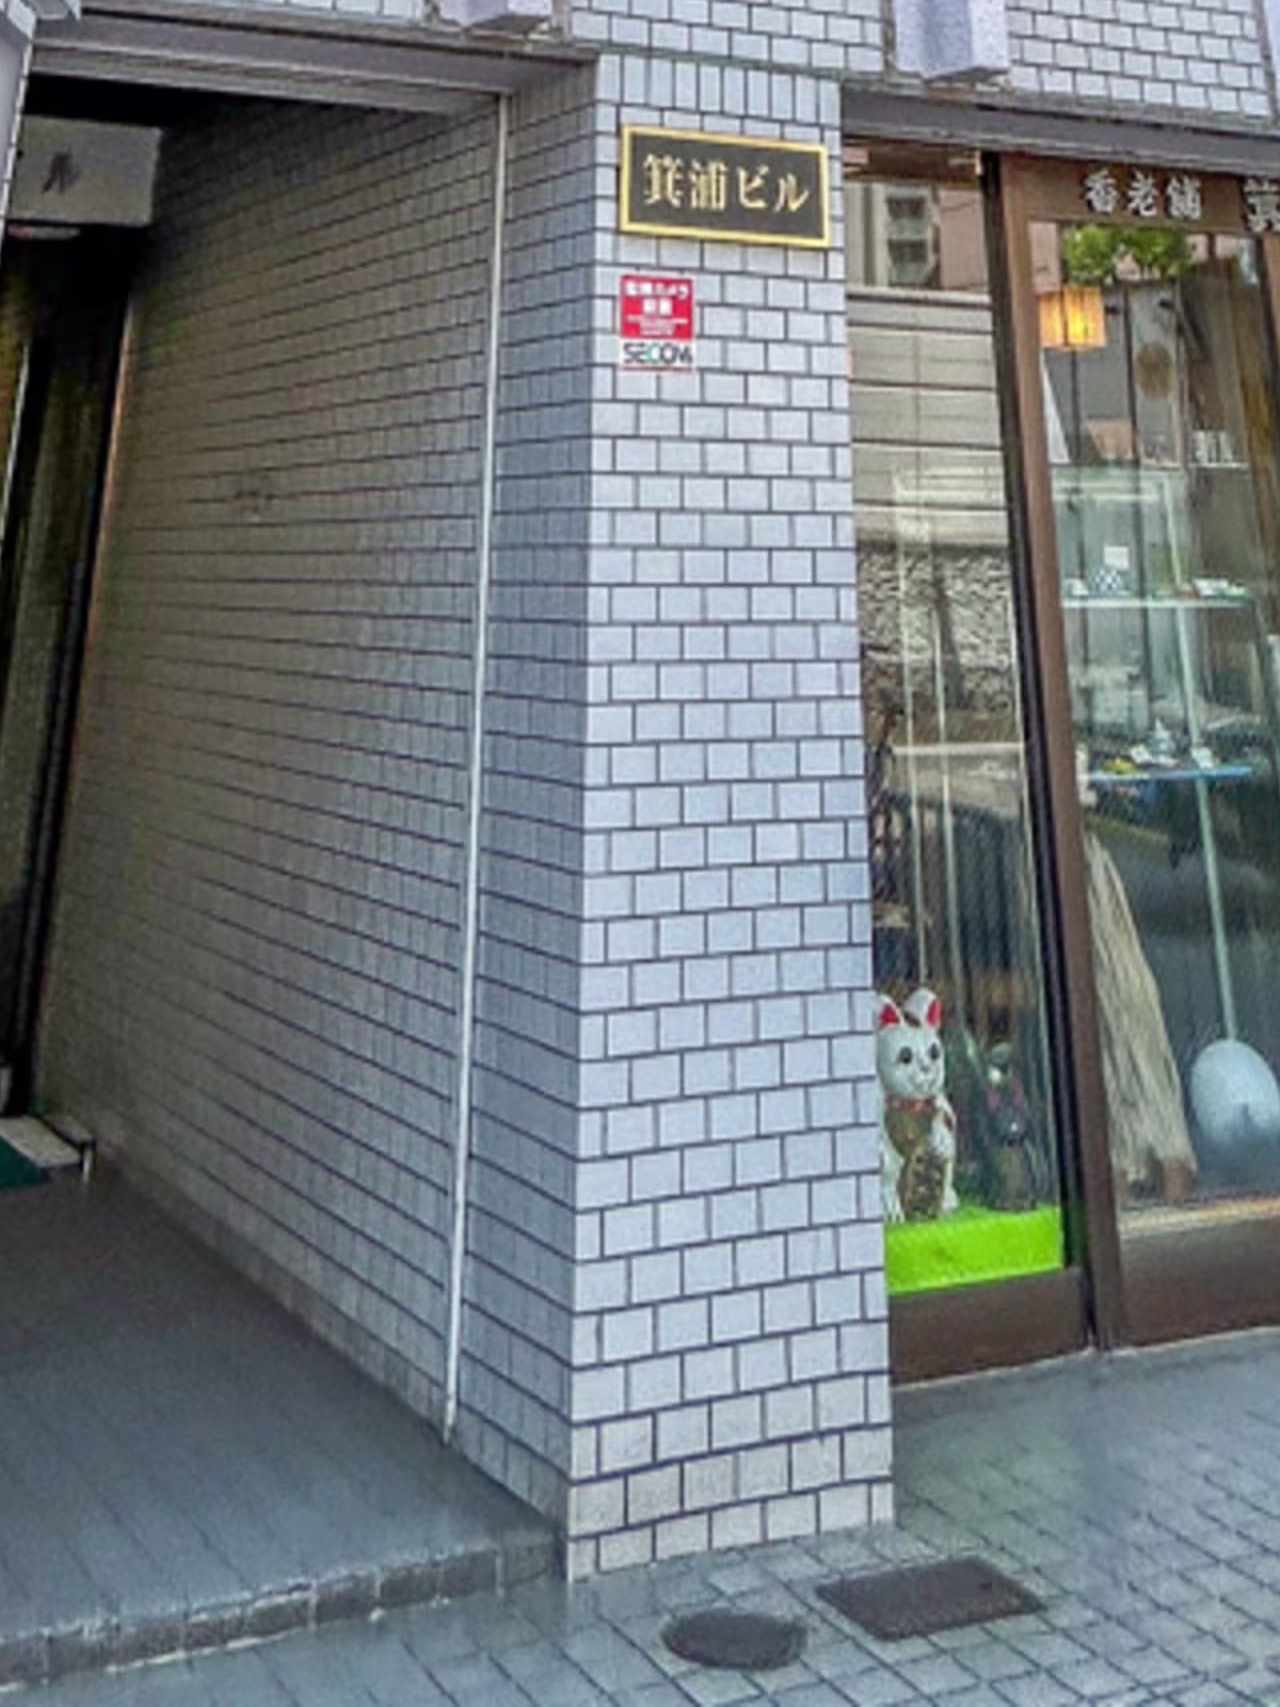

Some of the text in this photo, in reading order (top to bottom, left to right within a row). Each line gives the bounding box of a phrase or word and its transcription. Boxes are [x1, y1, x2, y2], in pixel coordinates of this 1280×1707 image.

[643, 153, 809, 213] 箕浦ビル
[1085, 168, 1203, 221] 香老舗
[623, 342, 694, 365] SECOM
